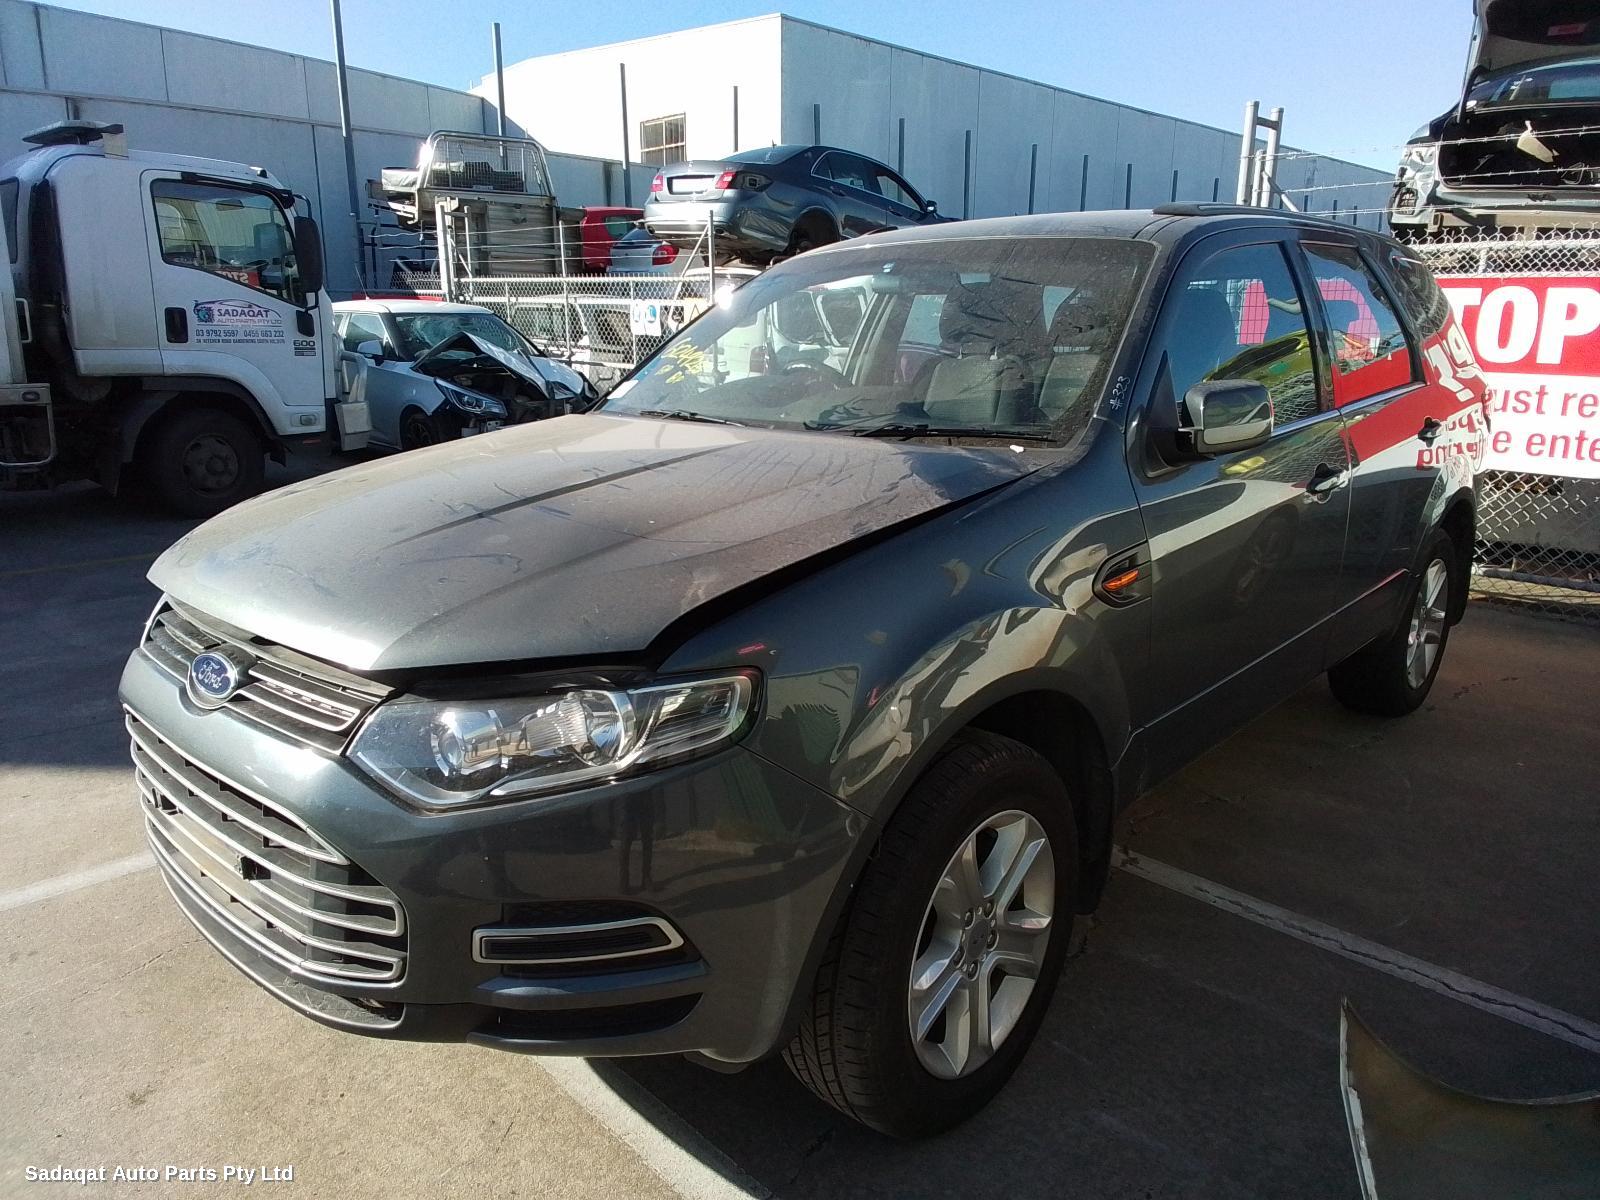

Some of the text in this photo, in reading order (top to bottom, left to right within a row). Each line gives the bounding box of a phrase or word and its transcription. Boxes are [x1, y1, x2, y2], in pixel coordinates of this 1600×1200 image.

[217, 308, 270, 318] SADAQAT
[1441, 285, 1600, 364] TOP
[195, 329, 204, 337] 03
[205, 329, 222, 338] 9792
[1492, 384, 1548, 415] ust
[1492, 430, 1512, 454] e
[198, 660, 225, 689] Ford
